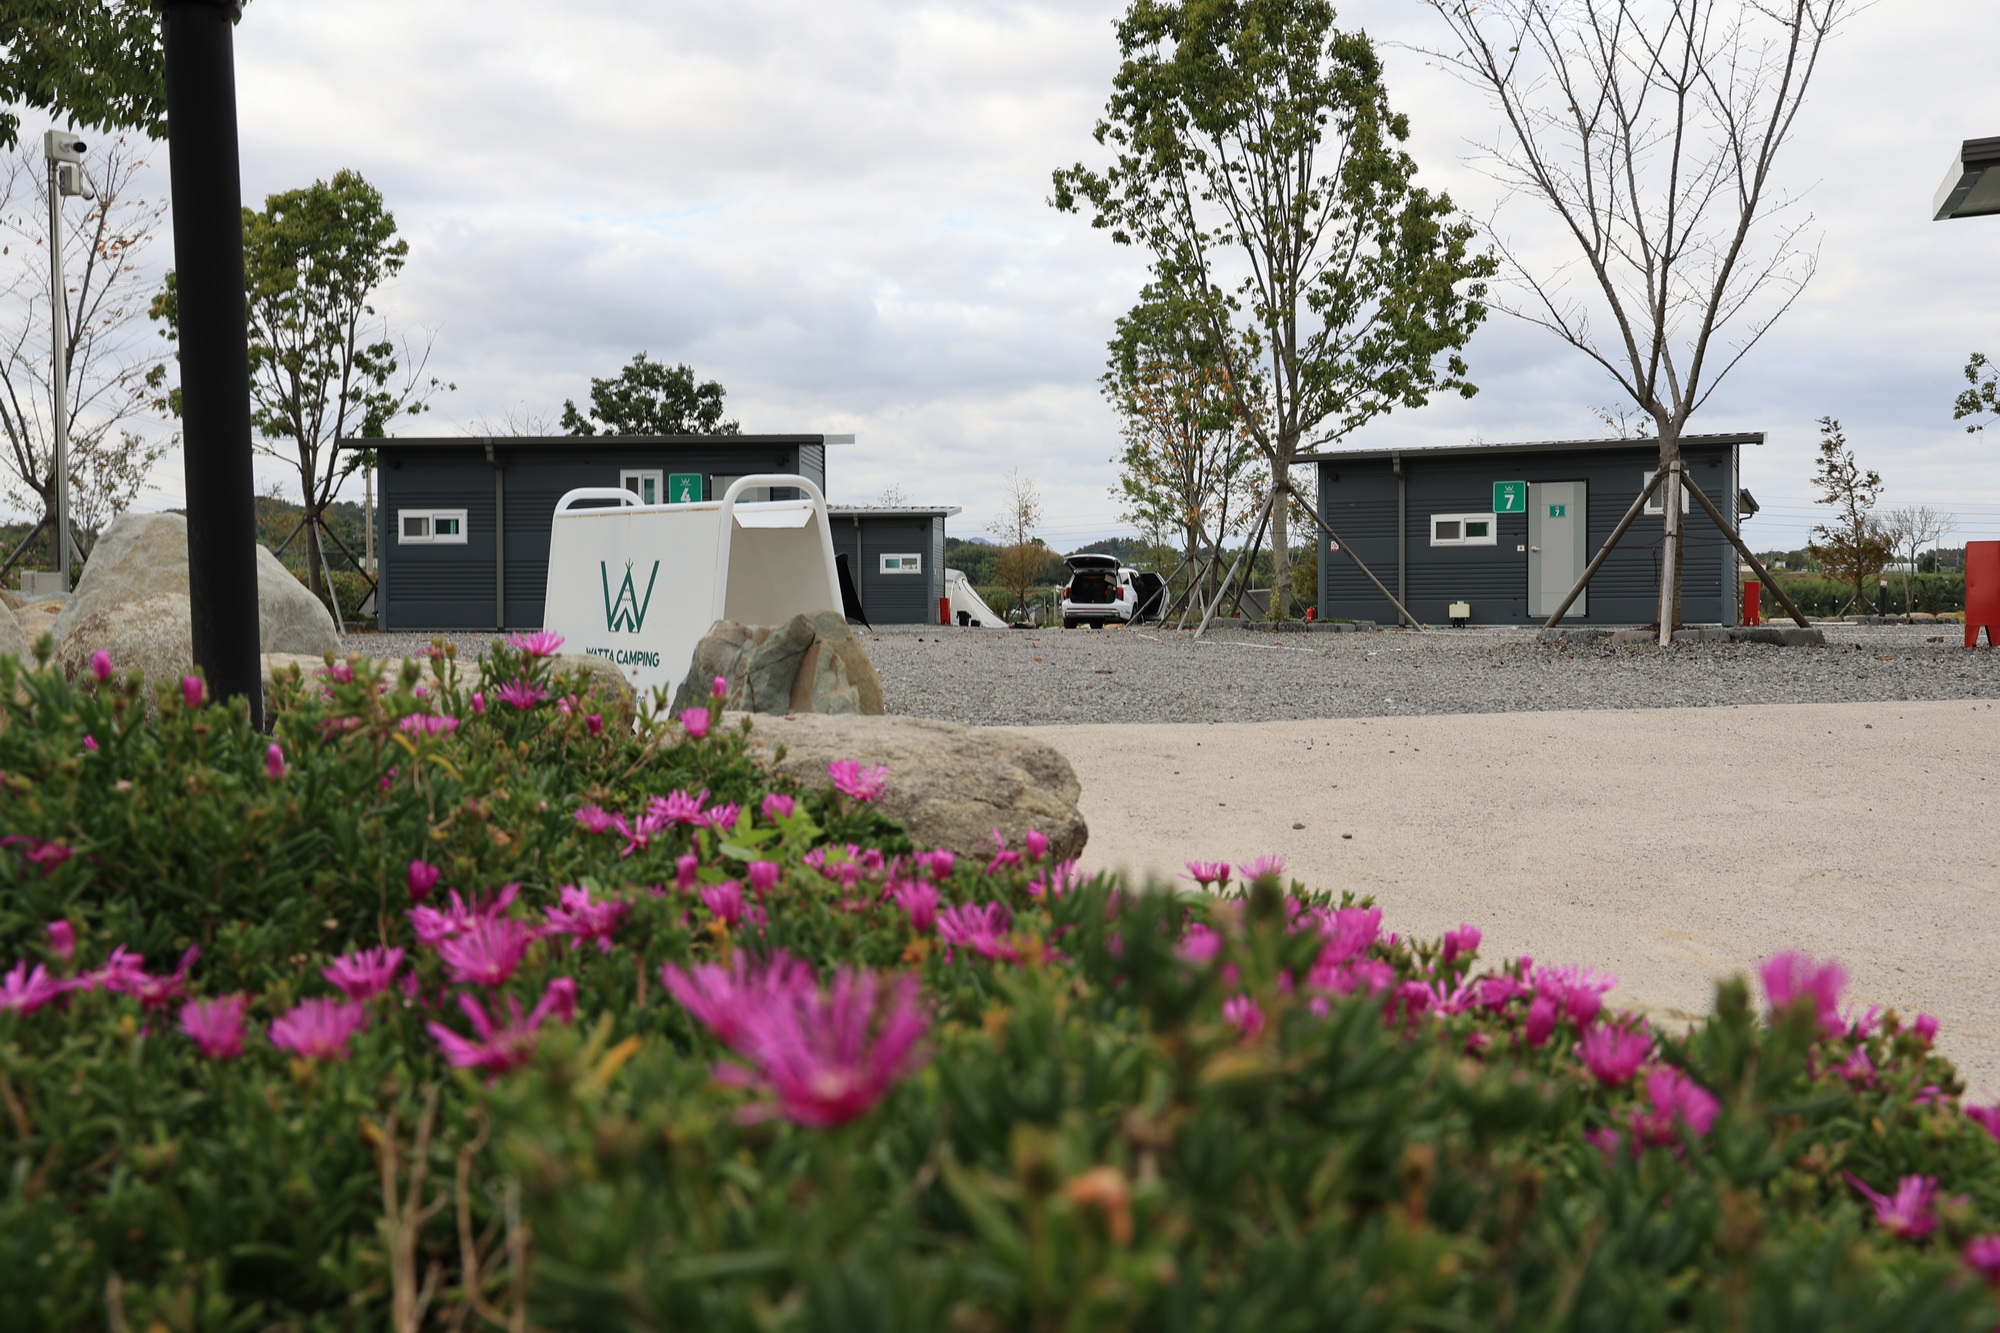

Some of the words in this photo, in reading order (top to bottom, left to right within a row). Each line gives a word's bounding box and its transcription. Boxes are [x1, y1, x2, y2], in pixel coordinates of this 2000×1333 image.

[680, 487, 691, 504] 4
[1504, 494, 1514, 509] 7
[616, 649, 660, 668] CAMPING
